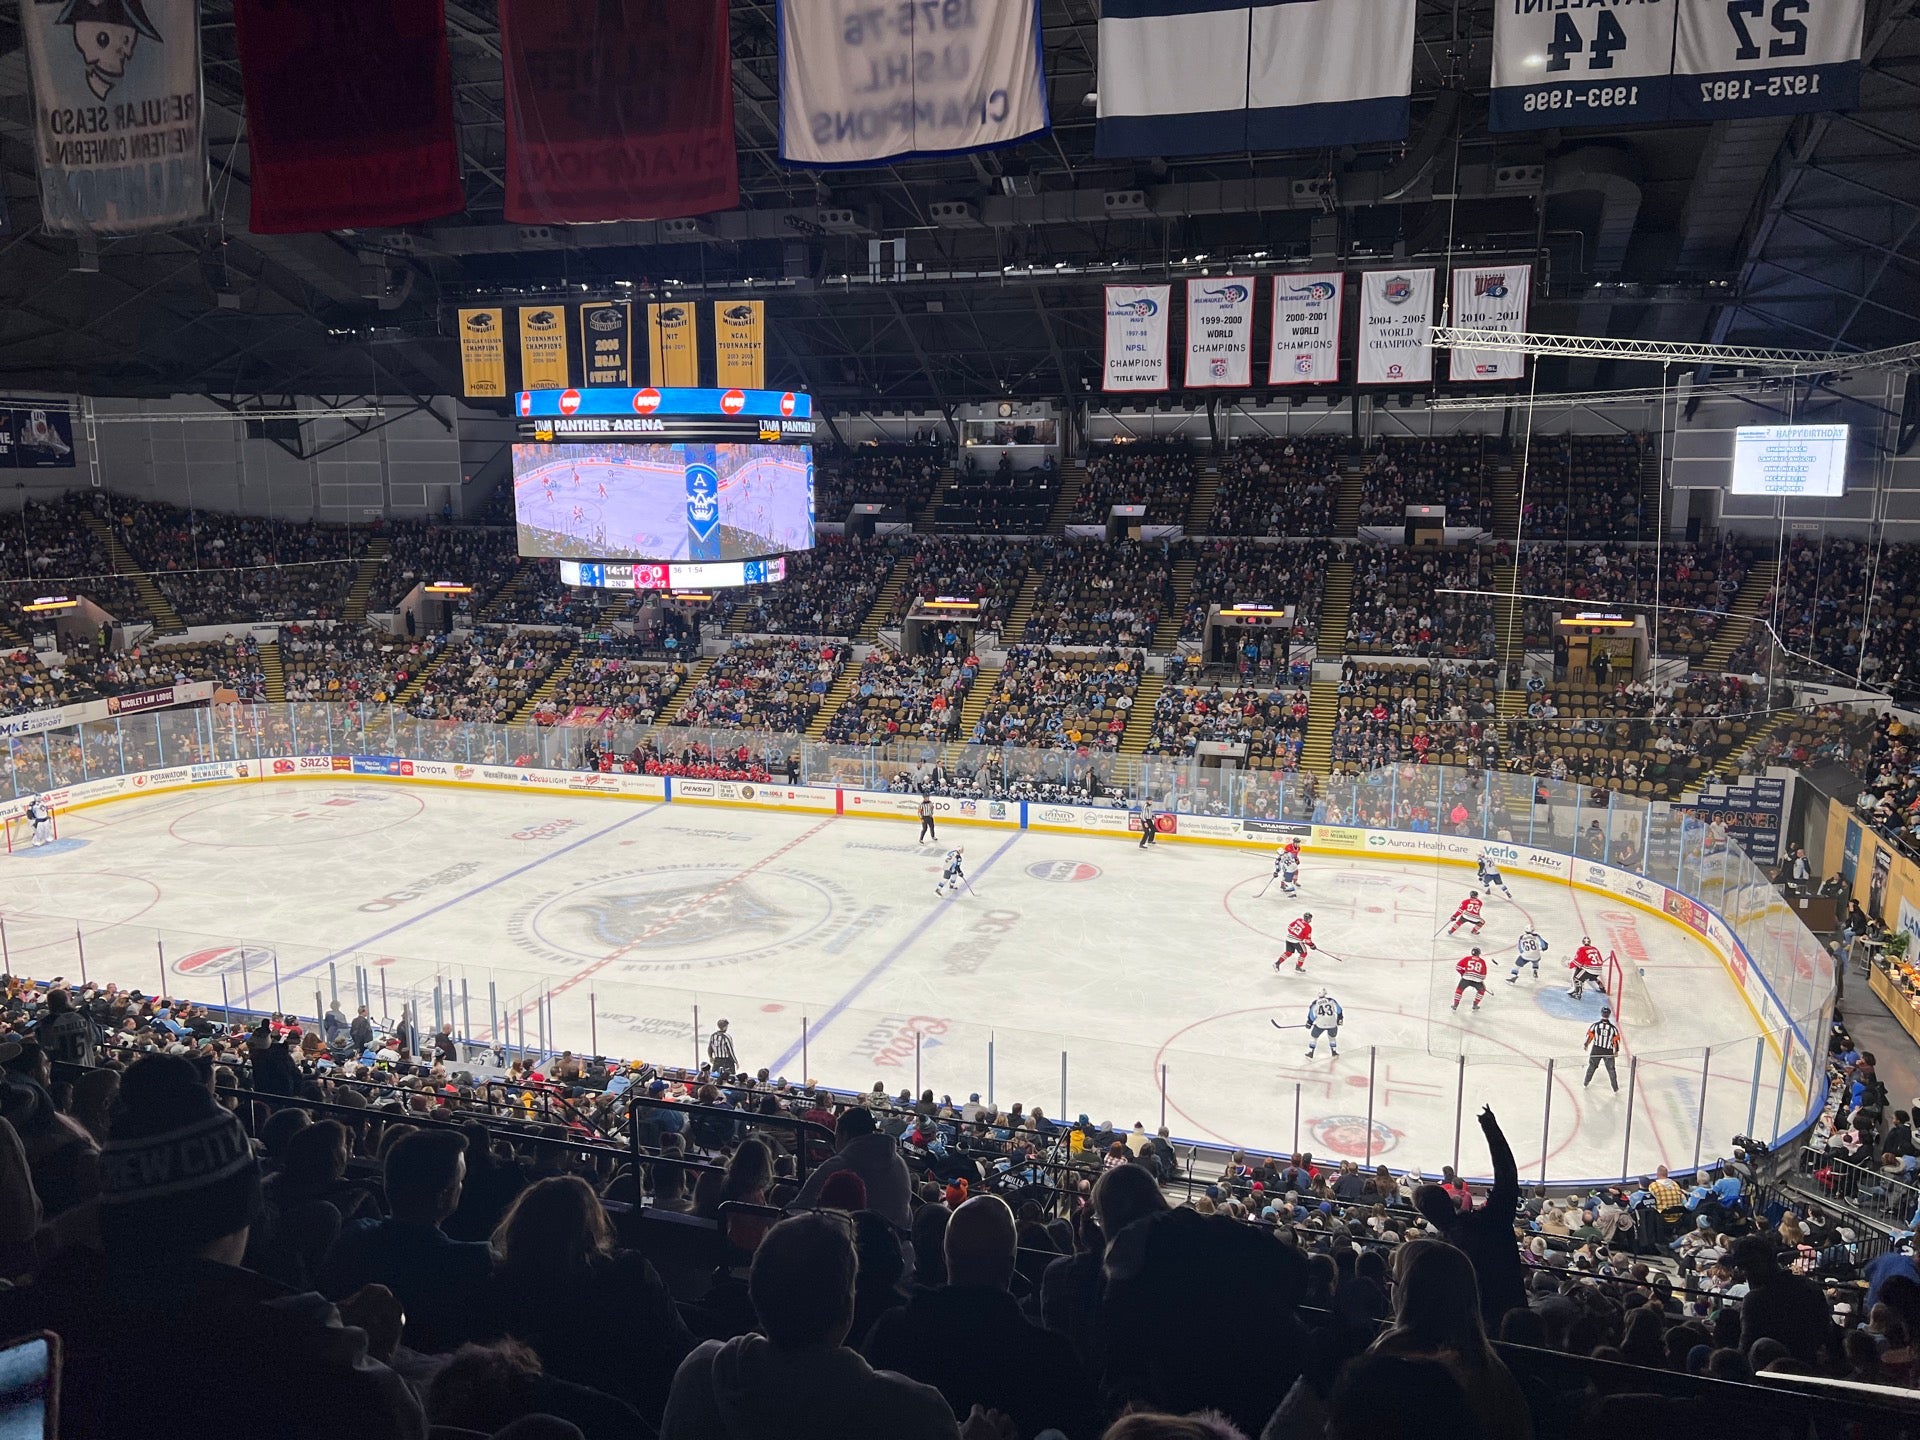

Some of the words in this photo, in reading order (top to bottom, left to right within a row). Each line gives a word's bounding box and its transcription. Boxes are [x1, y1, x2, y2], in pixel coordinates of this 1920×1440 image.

[1200, 316, 1242, 325] 1999-2000
[1285, 312, 1327, 322] 2000-2001
[1368, 316, 1391, 325] 2004
[1402, 314, 1426, 324] 2005
[1460, 313, 1486, 322] 2010
[1496, 311, 1519, 321] 2011
[466, 325, 496, 334] MILWAUKEE
[527, 322, 557, 332] MILWAUKEE
[1292, 327, 1319, 335] WORLD
[1207, 329, 1233, 338] WORLD
[1380, 328, 1413, 337] WORLD
[1192, 344, 1246, 352] CHAMPIONS
[1277, 340, 1332, 350] CHAMPIONS
[1369, 339, 1422, 349] CHAMPIONS
[594, 354, 621, 367] NCAA
[1110, 359, 1162, 368] CHAMPIONS
[554, 420, 610, 431] PANTHER
[613, 419, 665, 431] ARENA
[1776, 430, 1802, 438] HAPPY
[1803, 429, 1844, 438] BIRTHDAY
[693, 473, 707, 487] A
[606, 565, 632, 575] 14:17
[652, 566, 662, 578] 0
[688, 566, 703, 574] 1:54
[120, 697, 142, 709] NICOLET
[143, 694, 155, 704] LAW
[156, 691, 173, 701] LODGE
[0, 720, 29, 736] MKE
[31, 719, 62, 730] AIRPORT
[192, 769, 227, 779] MILWAUKEE
[416, 765, 447, 774] TOYOTA
[151, 769, 188, 781] POTAWATOMI
[528, 773, 549, 783] Coors
[960, 801, 976, 810] 175
[1712, 810, 1778, 829] CORNER
[512, 819, 573, 840] Coors
[1178, 821, 1200, 829] Modern
[1201, 823, 1230, 831] Woodmen
[1259, 823, 1295, 831] UMANSKY
[1388, 838, 1416, 848] Aurora
[1418, 840, 1446, 851] Health
[1448, 844, 1469, 853] Care
[1467, 960, 1482, 971] 58
[1318, 1004, 1333, 1016] 43
